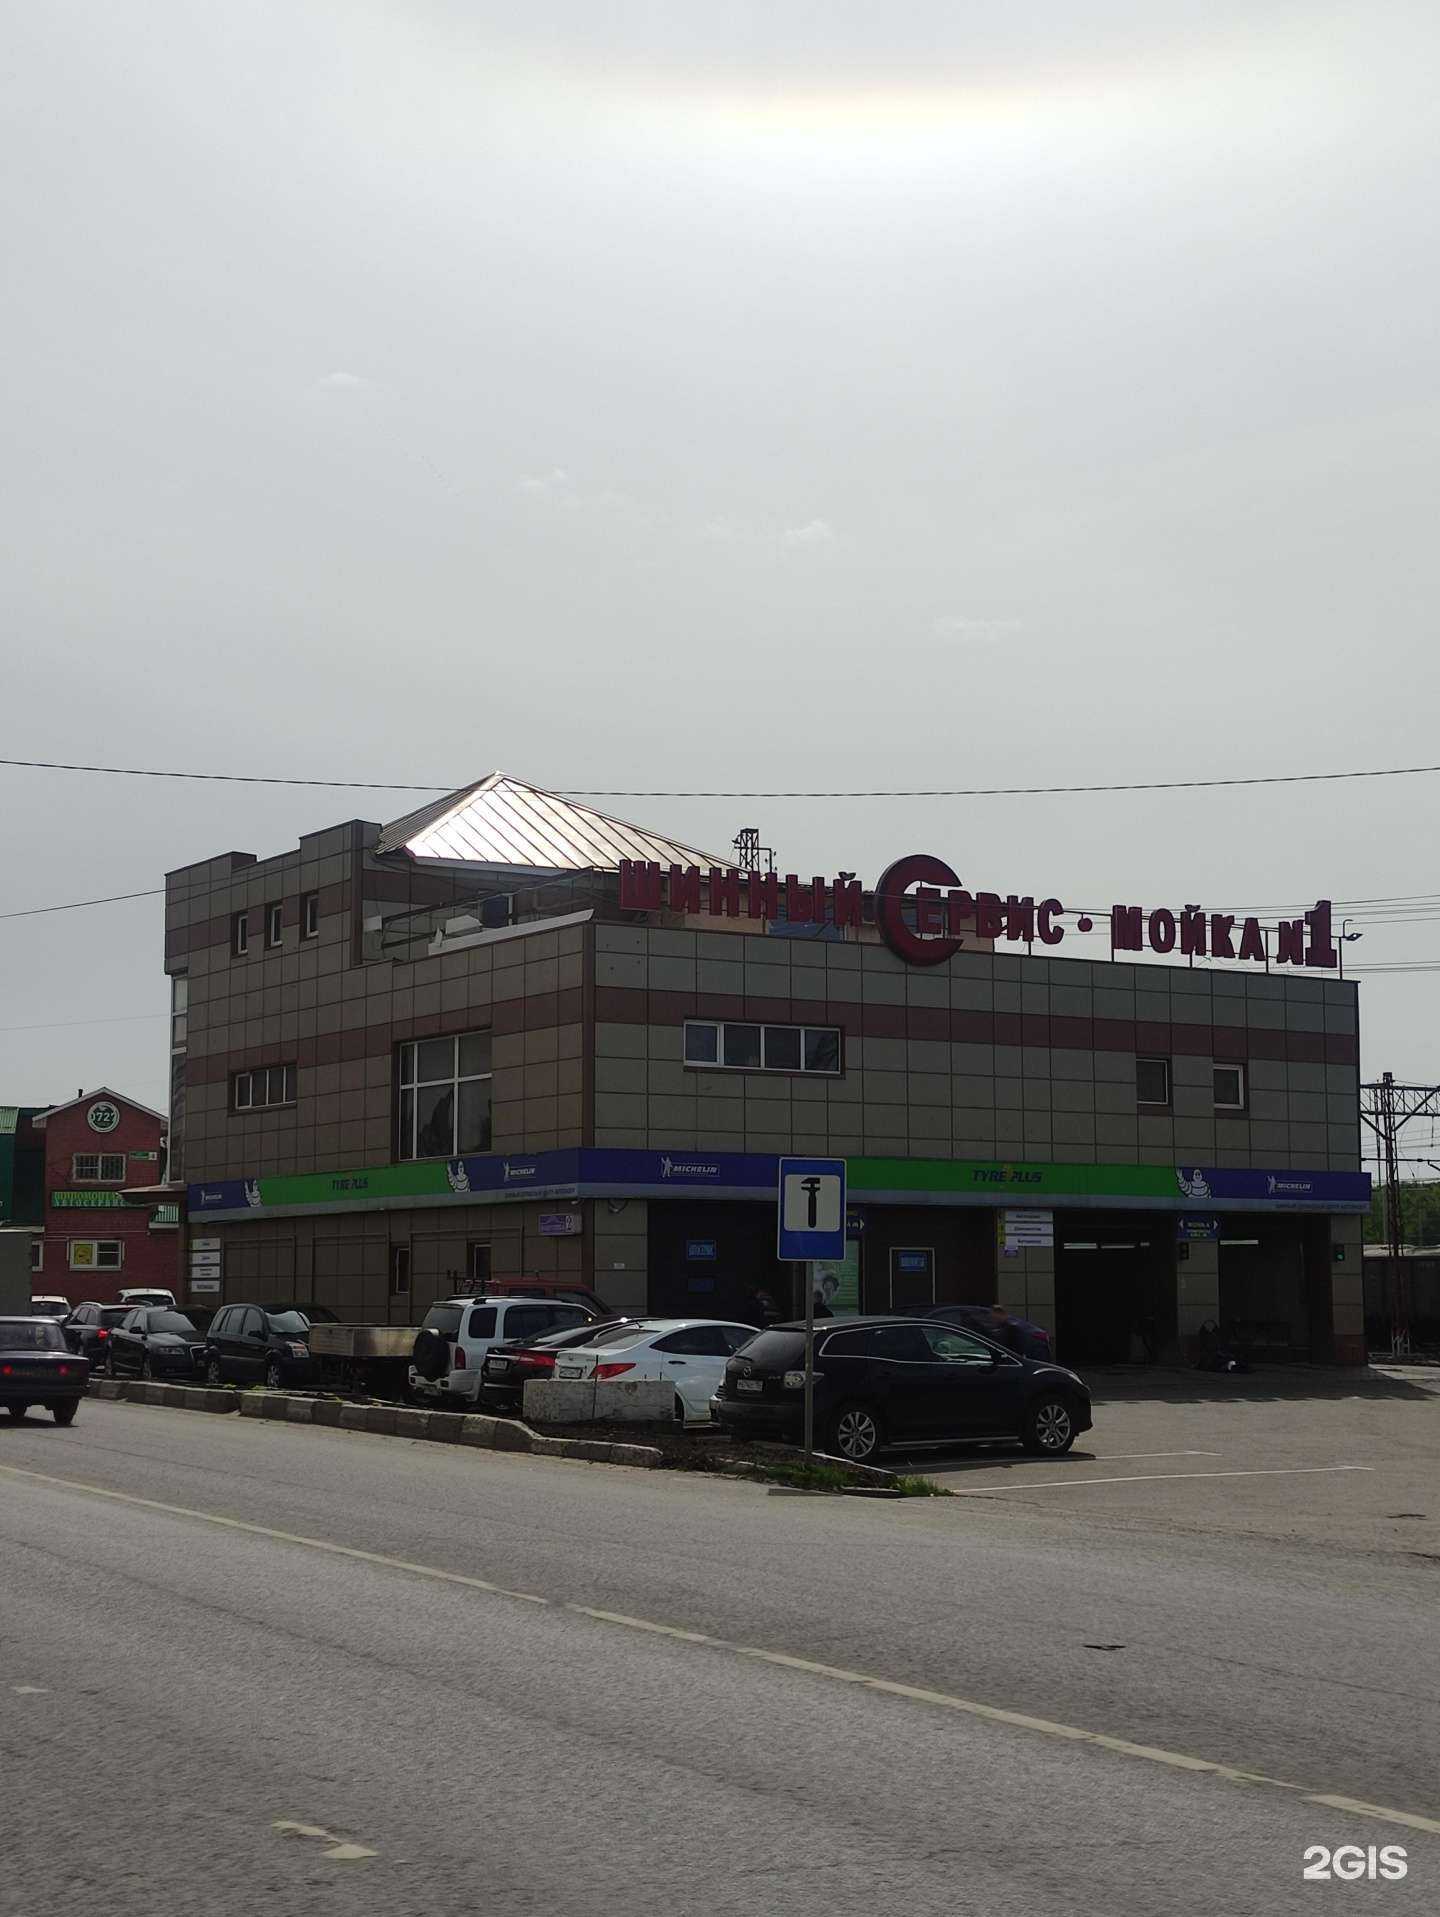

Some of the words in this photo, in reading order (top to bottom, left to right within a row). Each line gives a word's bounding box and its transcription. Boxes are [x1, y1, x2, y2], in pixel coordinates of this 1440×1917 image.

[619, 859, 862, 928] ШИННЫЙ
[876, 854, 1064, 967] СЕРВИС
[1111, 904, 1266, 961] МОЙКА
[672, 1164, 718, 1174] MICHELIN
[1275, 1182, 1312, 1192] MICHELIN
